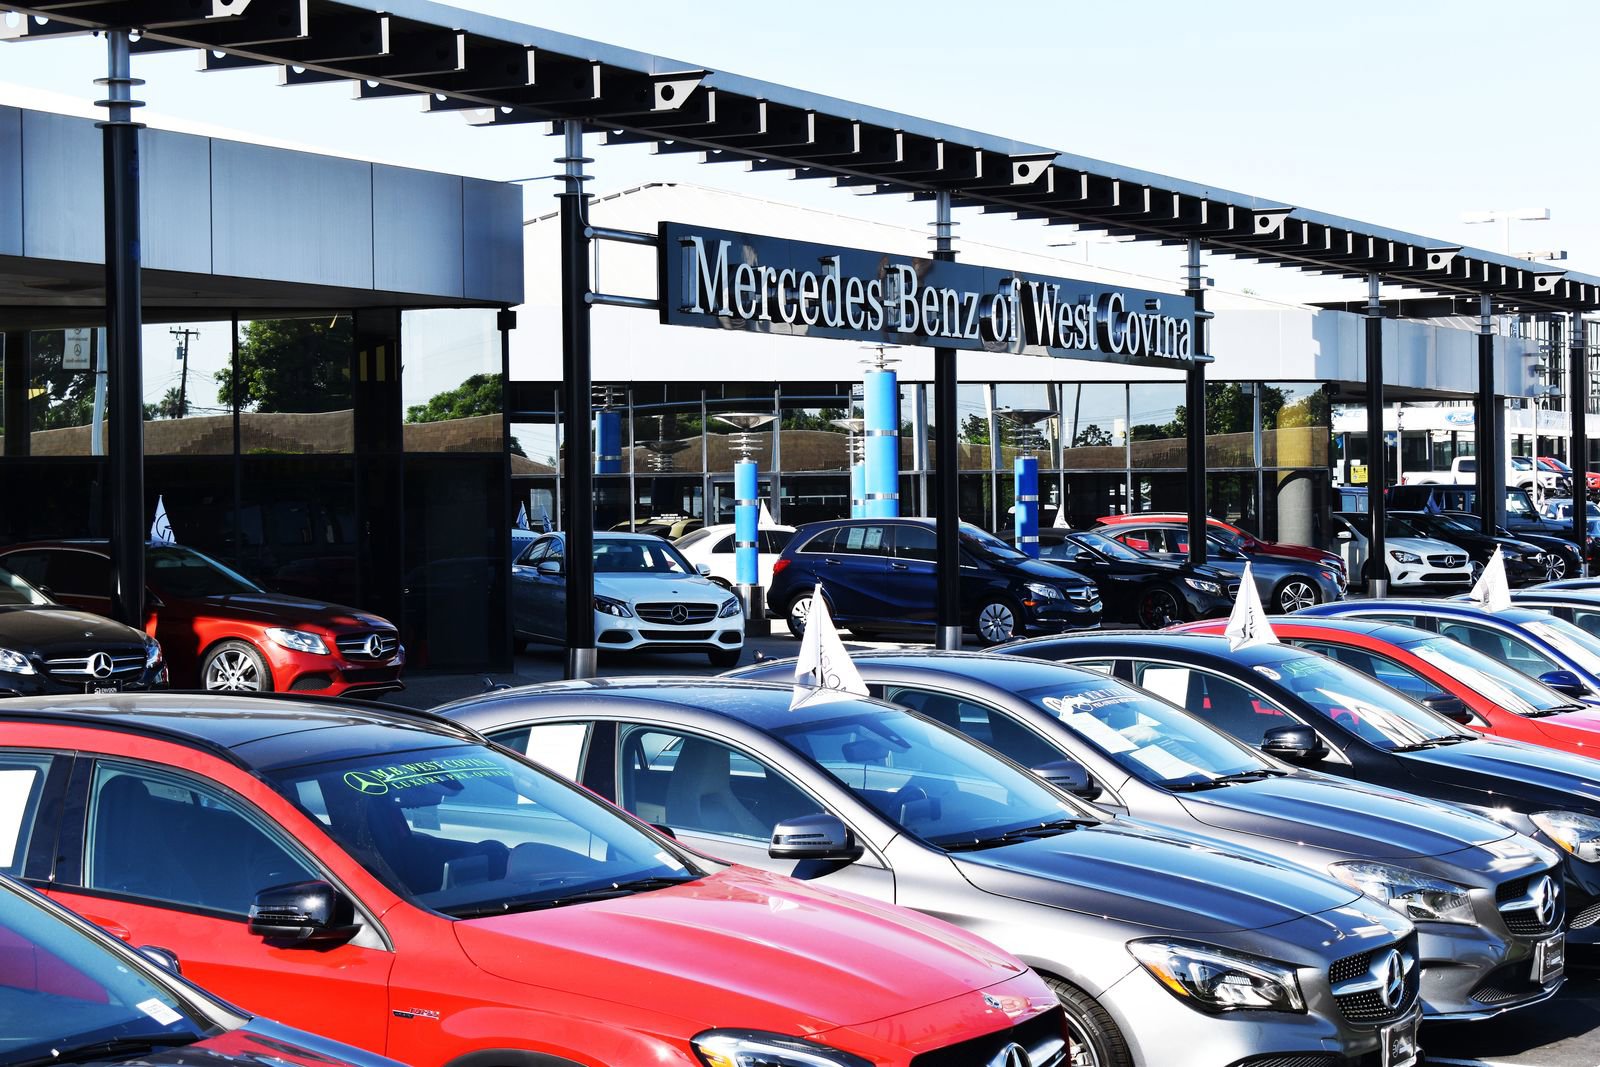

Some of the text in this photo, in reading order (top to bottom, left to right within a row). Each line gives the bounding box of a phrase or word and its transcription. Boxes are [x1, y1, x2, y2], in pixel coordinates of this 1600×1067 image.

[689, 235, 1194, 362] Mercedes-Benz of West Covina
[404, 760, 444, 774] WEST
[392, 774, 445, 789] LUXURY
